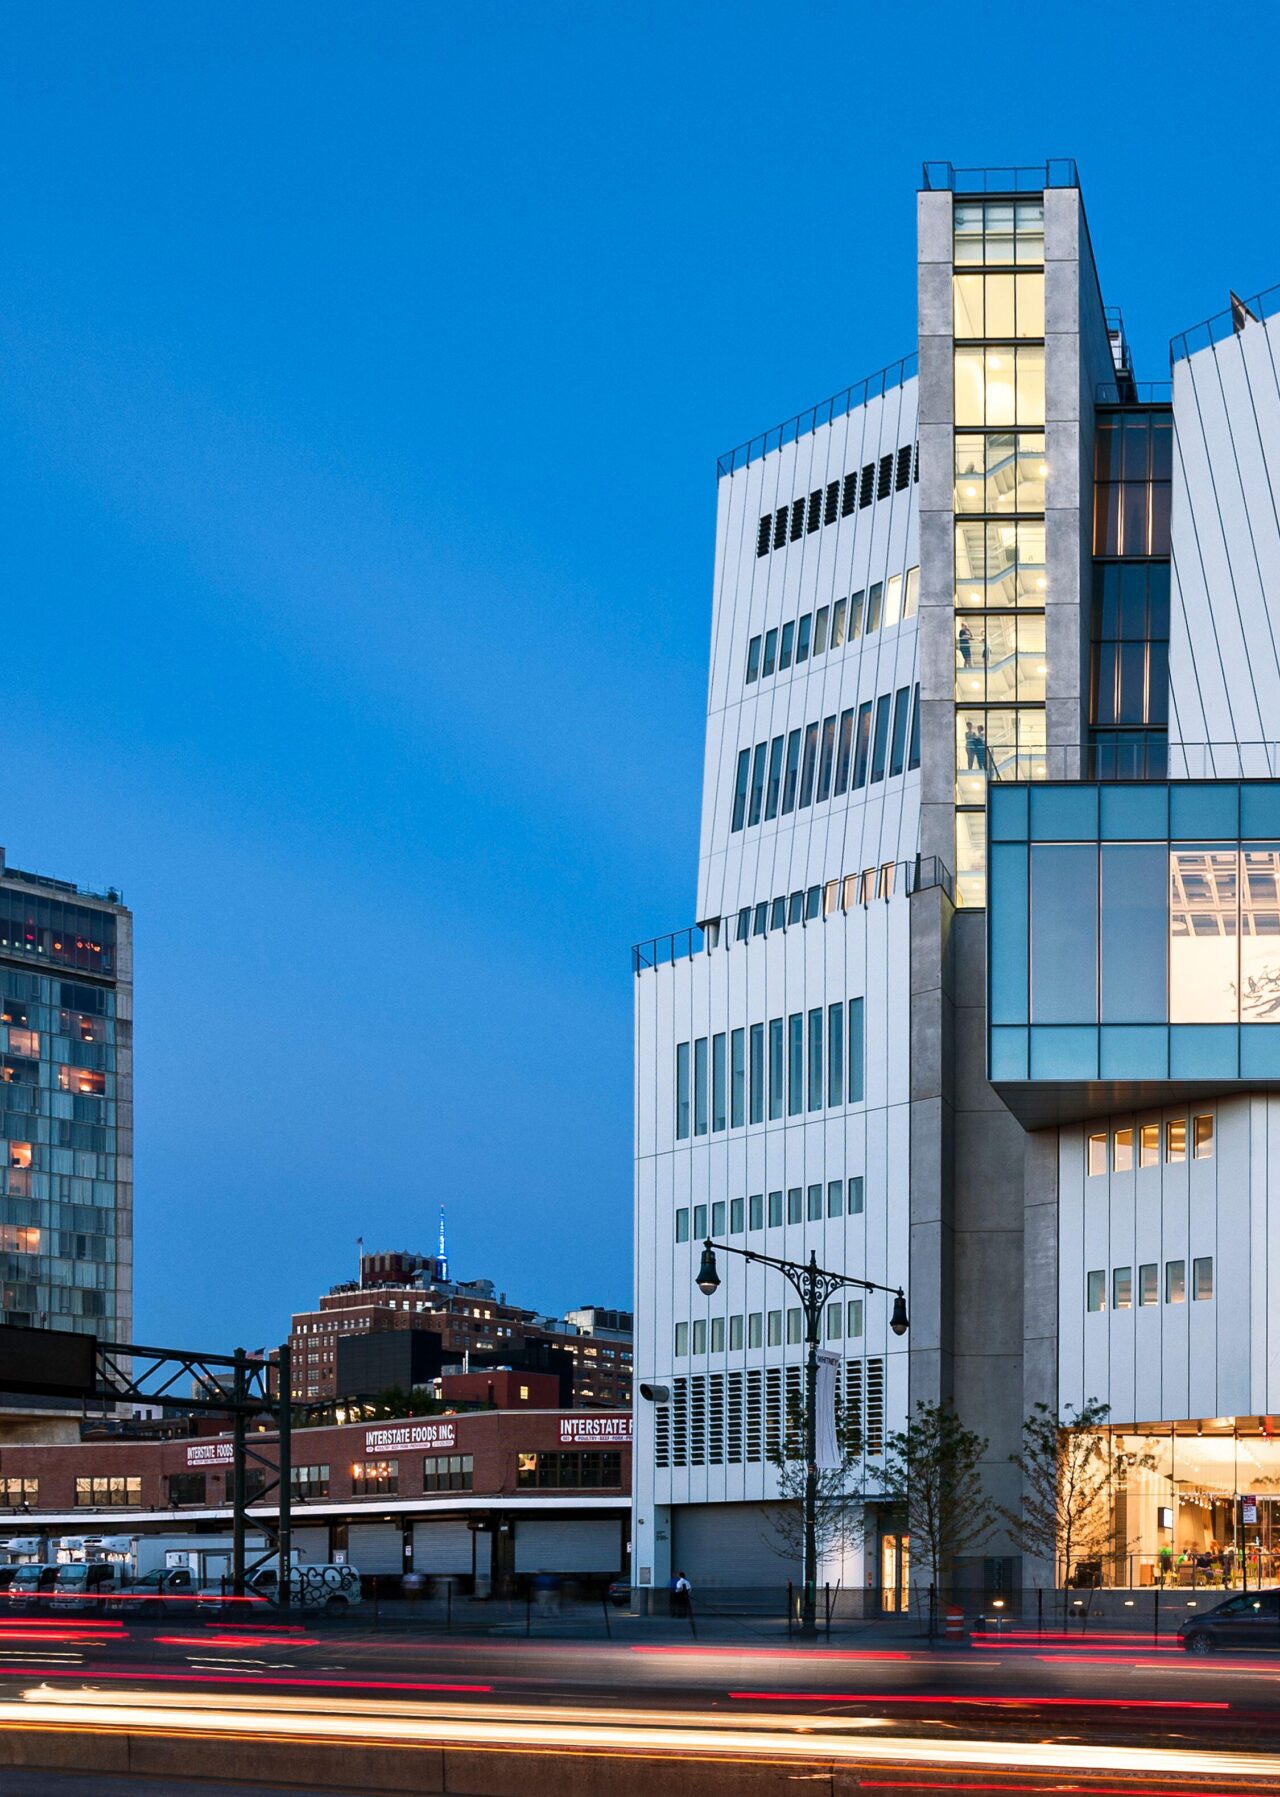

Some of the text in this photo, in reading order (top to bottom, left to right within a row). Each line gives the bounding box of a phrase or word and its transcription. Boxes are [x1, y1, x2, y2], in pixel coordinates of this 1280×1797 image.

[560, 1419, 627, 1434] INTERSTATE
[366, 1424, 455, 1445] INTERSTATE FOODS INC.
[187, 1444, 234, 1459] INTERSTATE FOODS
